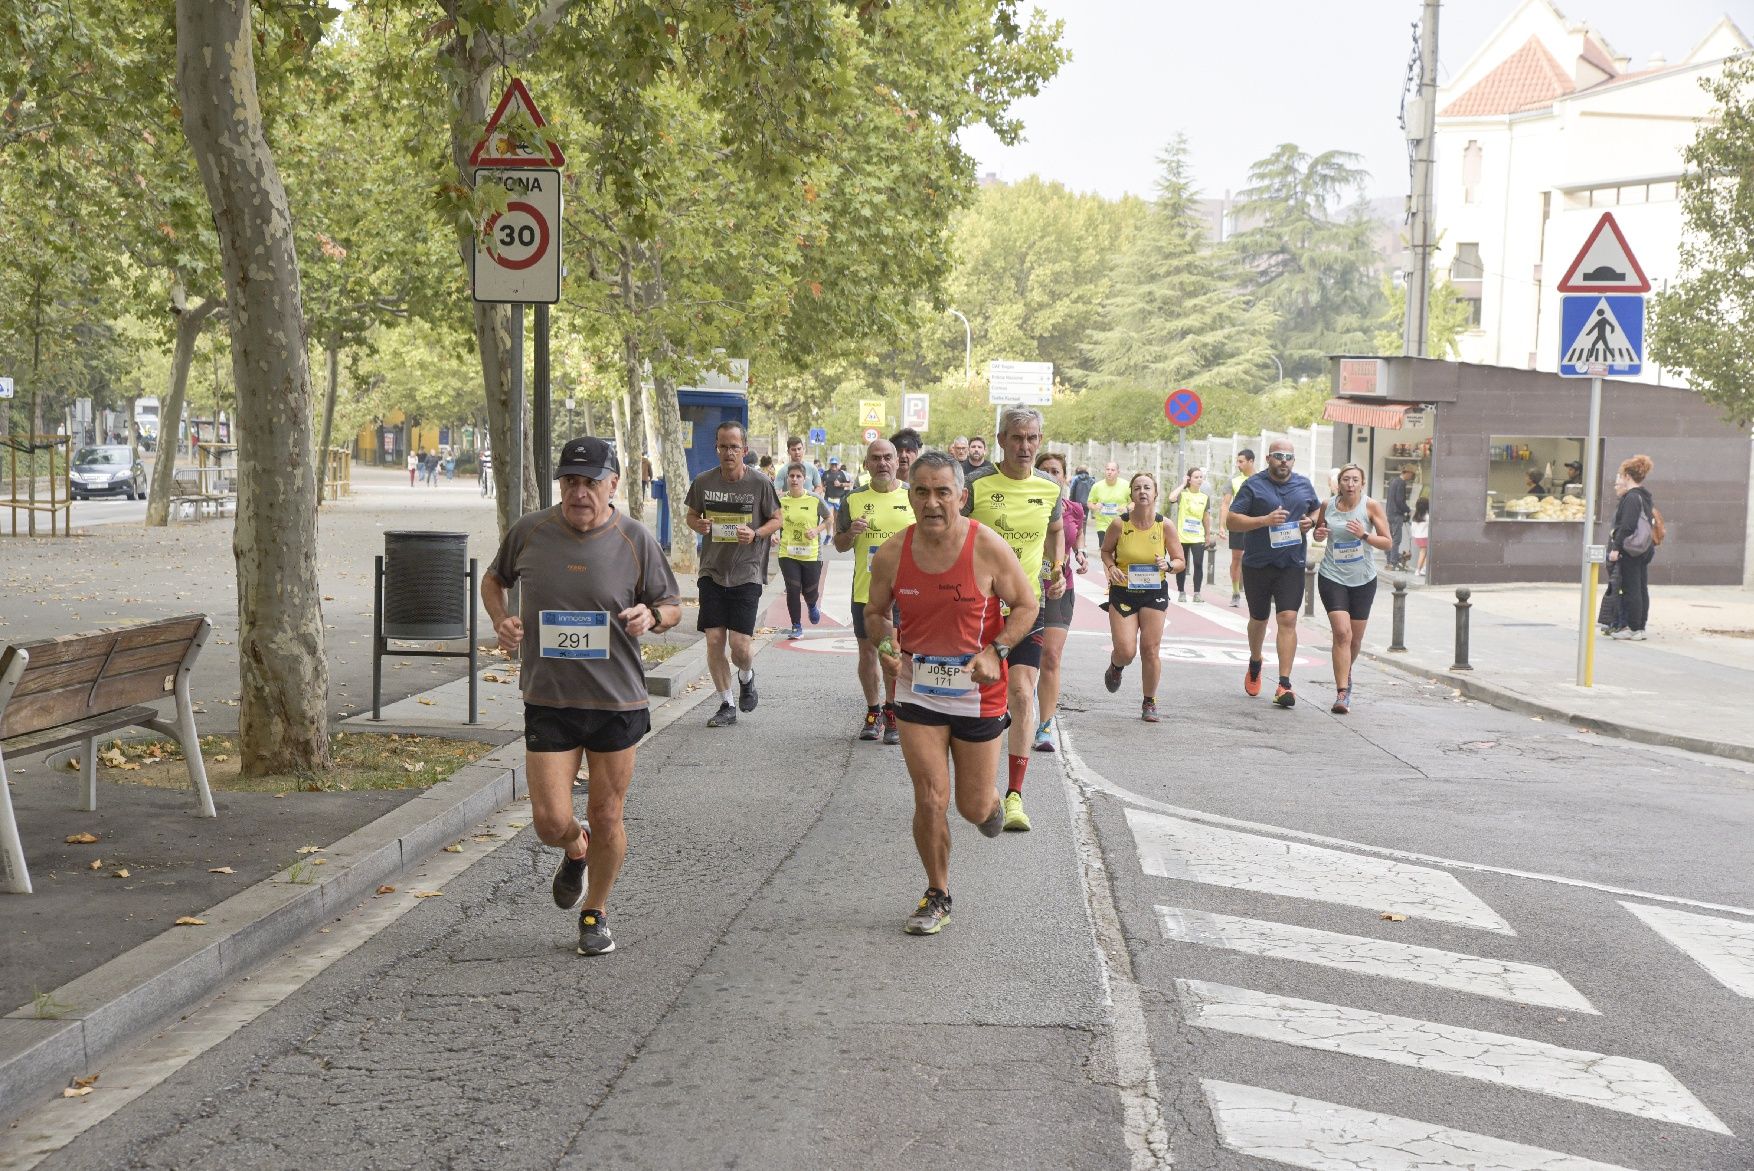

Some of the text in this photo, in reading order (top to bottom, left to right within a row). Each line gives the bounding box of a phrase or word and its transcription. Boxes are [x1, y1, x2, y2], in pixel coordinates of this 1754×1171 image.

[499, 224, 535, 246] 30
[557, 632, 589, 649] 291
[927, 665, 961, 676] JOSEP
[935, 677, 952, 687] 171
